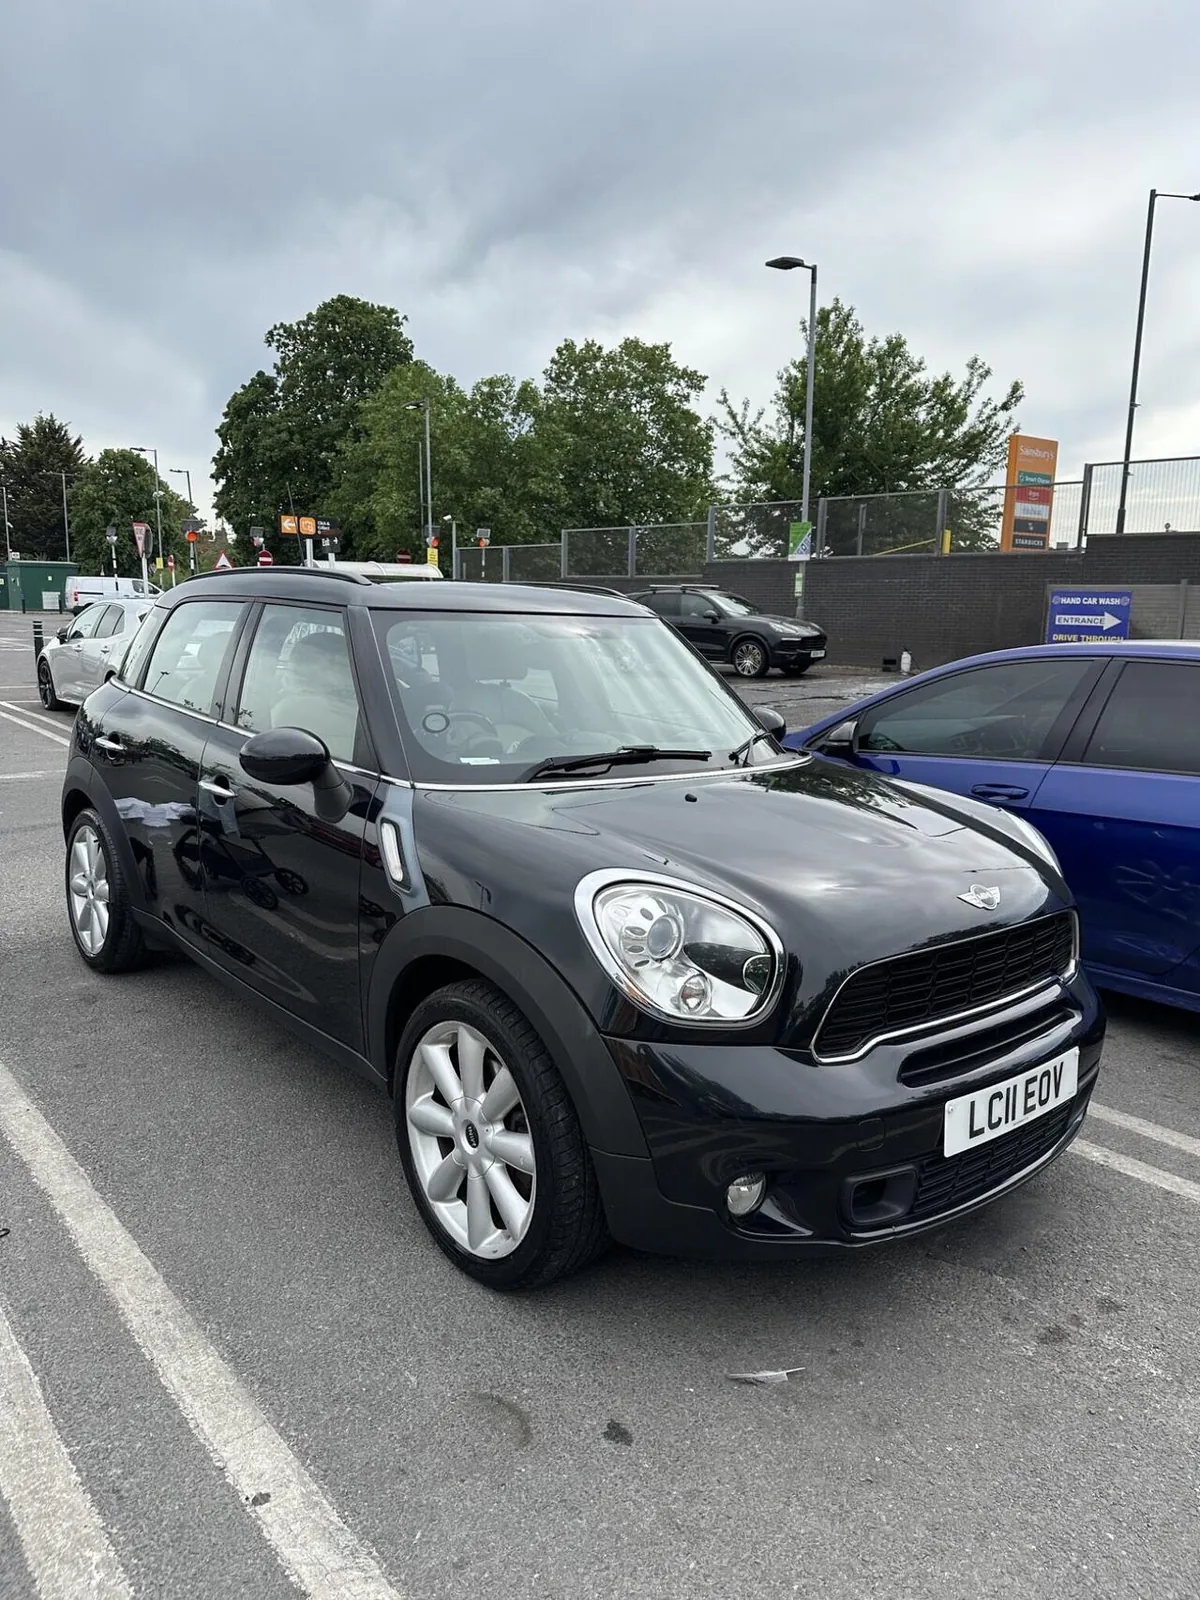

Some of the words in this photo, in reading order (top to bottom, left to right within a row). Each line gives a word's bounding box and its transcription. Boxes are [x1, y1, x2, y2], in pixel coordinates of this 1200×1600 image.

[1020, 445, 1054, 461] Sainsbury's
[1082, 597, 1097, 605] CAR
[1099, 597, 1121, 605] WASH
[1058, 616, 1105, 624] ENTRANCE
[1080, 635, 1124, 643] THROUGH
[969, 1084, 1018, 1139] LC11
[1023, 1061, 1064, 1115] EOV
